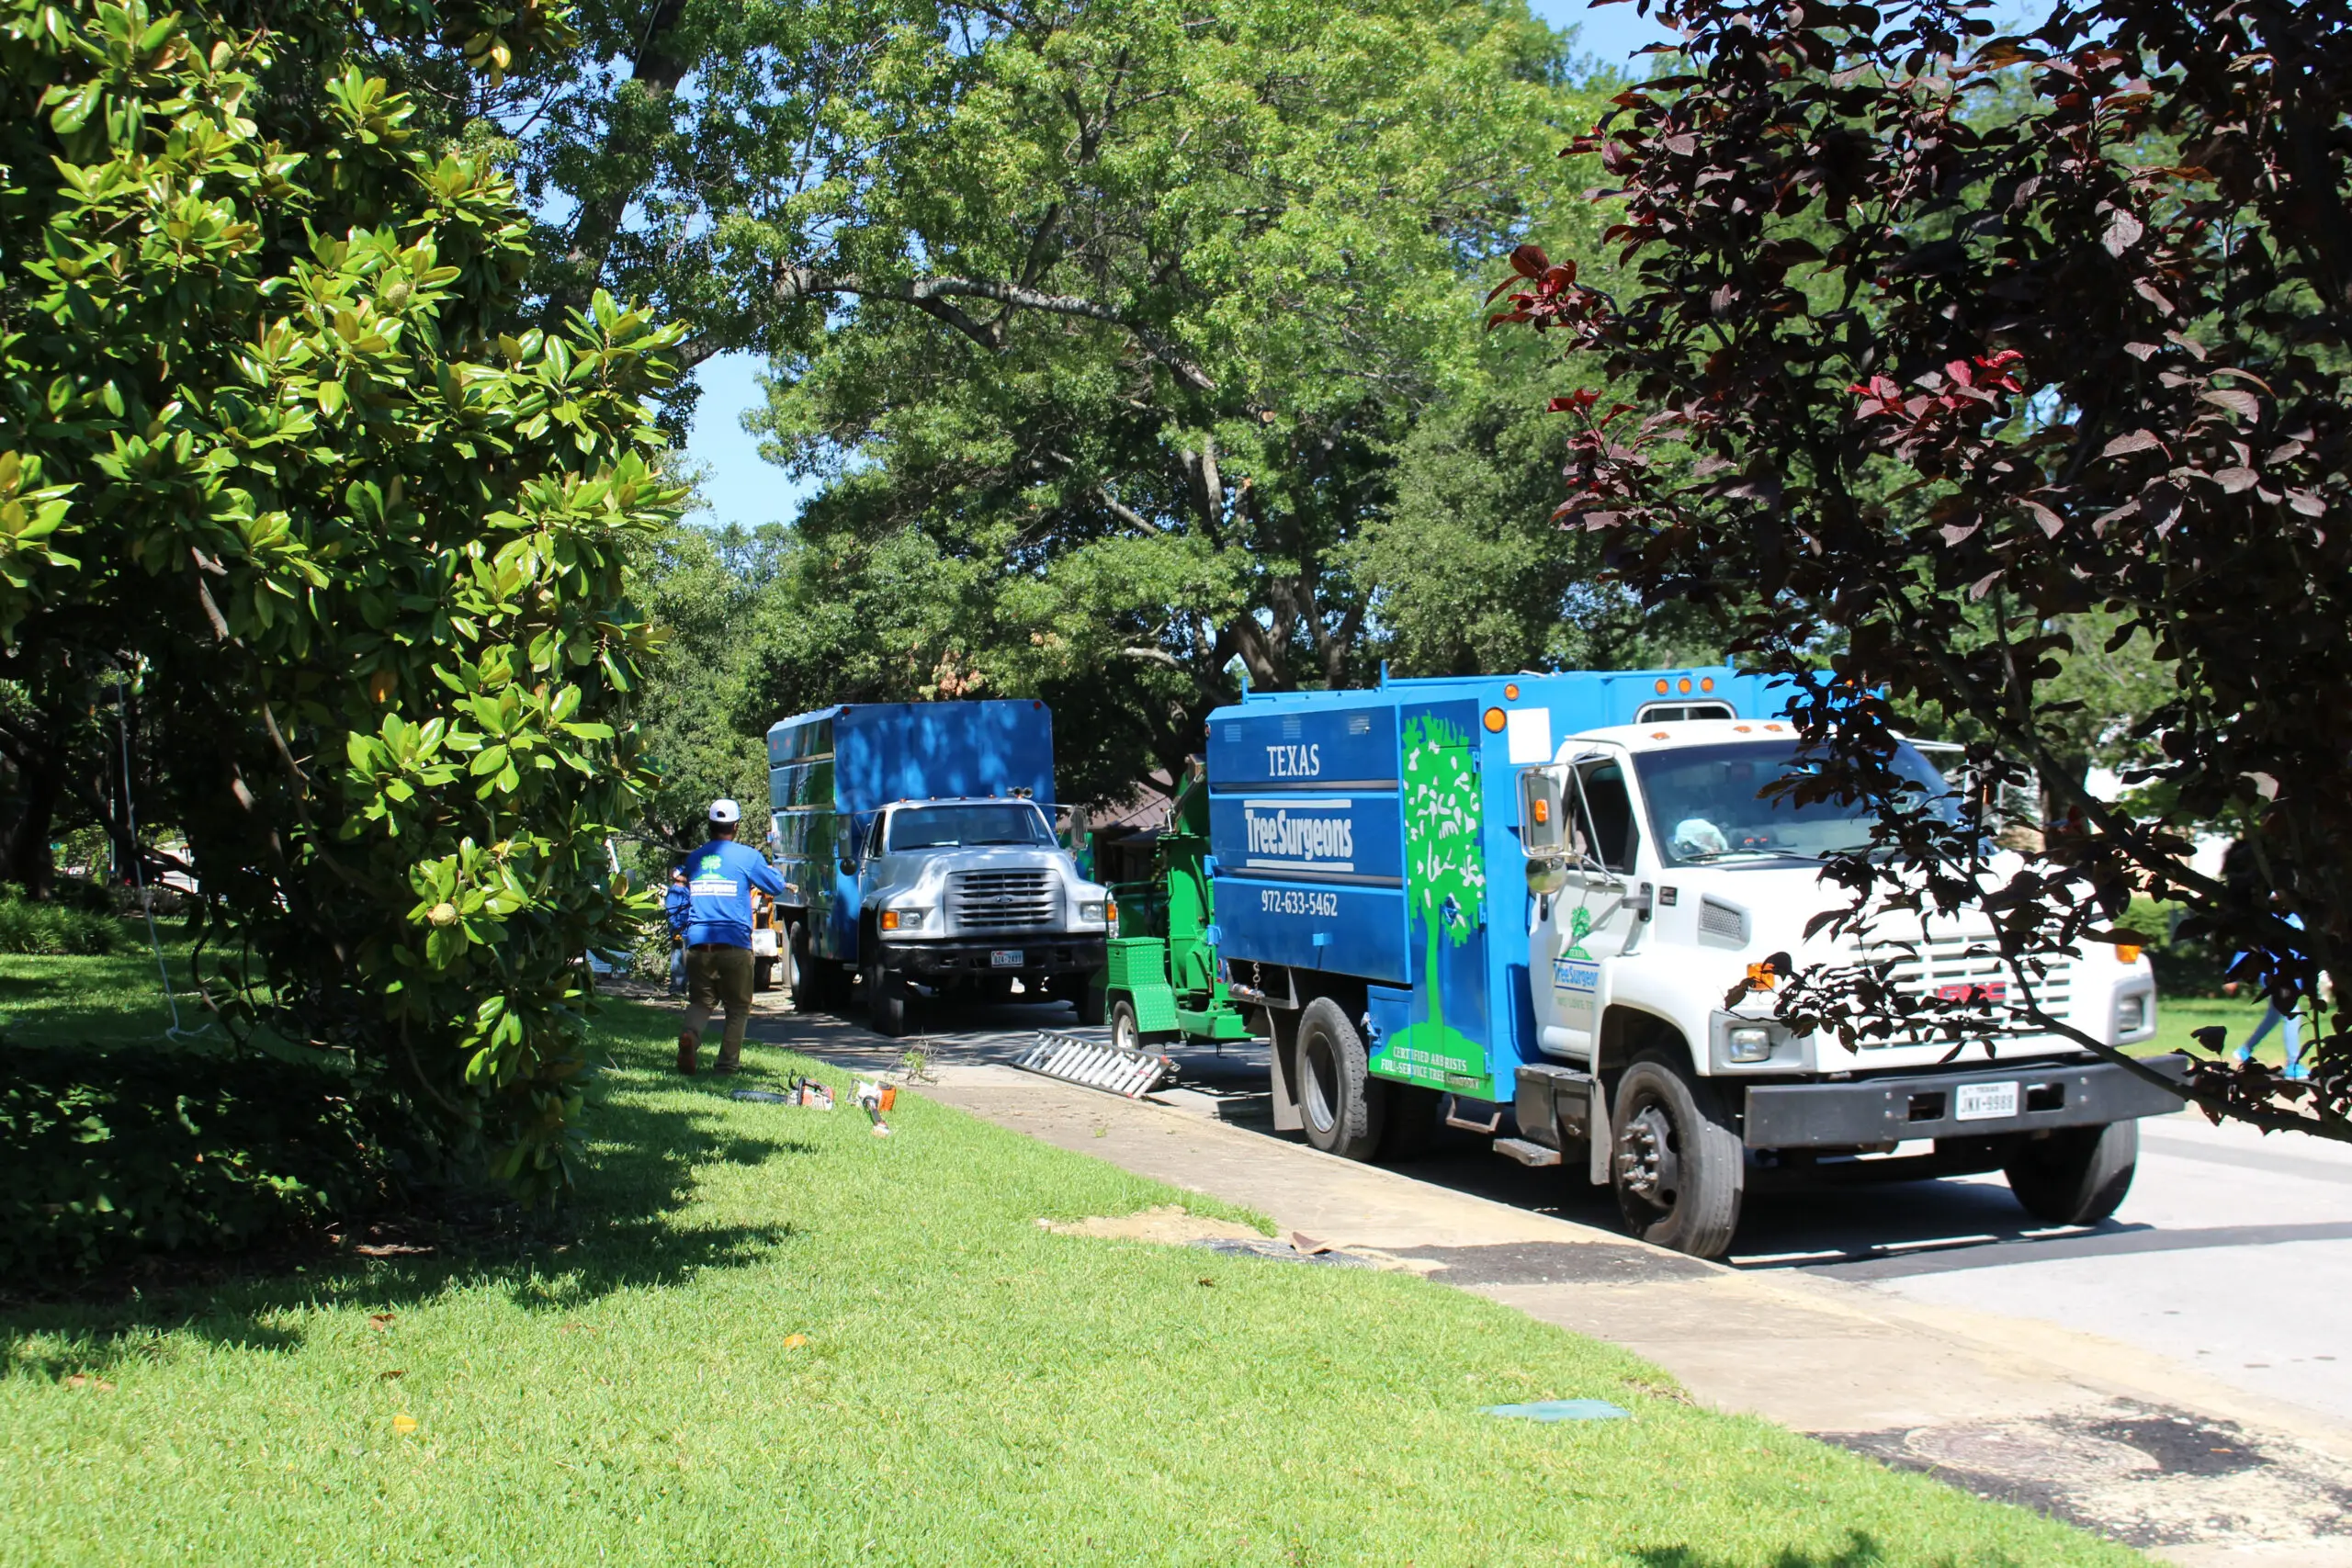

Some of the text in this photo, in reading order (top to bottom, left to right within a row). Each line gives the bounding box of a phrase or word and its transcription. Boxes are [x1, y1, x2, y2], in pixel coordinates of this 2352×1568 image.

[1266, 744, 1320, 777] TEXAS
[1245, 809, 1353, 861] TreeSurgeons
[1261, 889, 1338, 917] 972-633-5462
[1393, 1045, 1430, 1064] CERTIFIED
[1429, 1067, 1445, 1083] TREE
